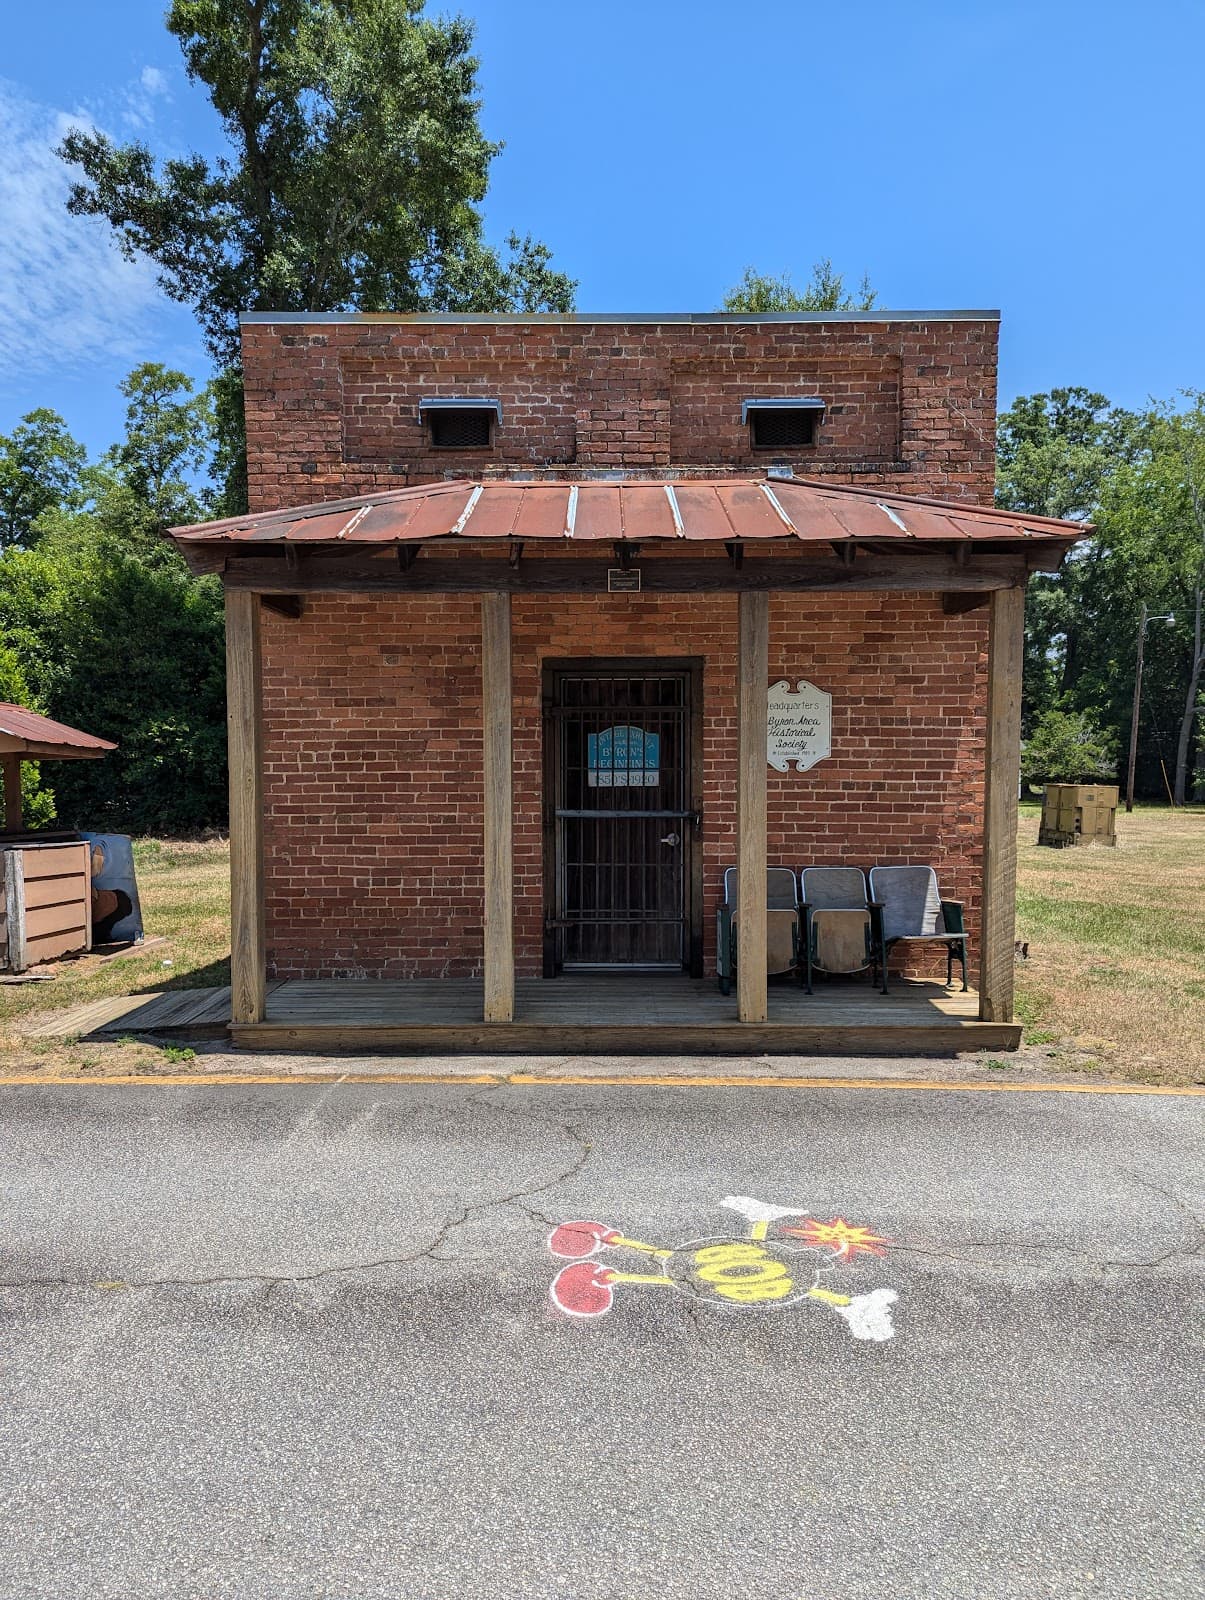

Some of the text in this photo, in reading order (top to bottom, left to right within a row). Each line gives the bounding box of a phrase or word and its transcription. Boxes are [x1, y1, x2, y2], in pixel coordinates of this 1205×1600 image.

[768, 701, 820, 713] eadquarters
[768, 715, 821, 729] Byron Area
[768, 727, 816, 737] Historical
[775, 738, 808, 751] Society
